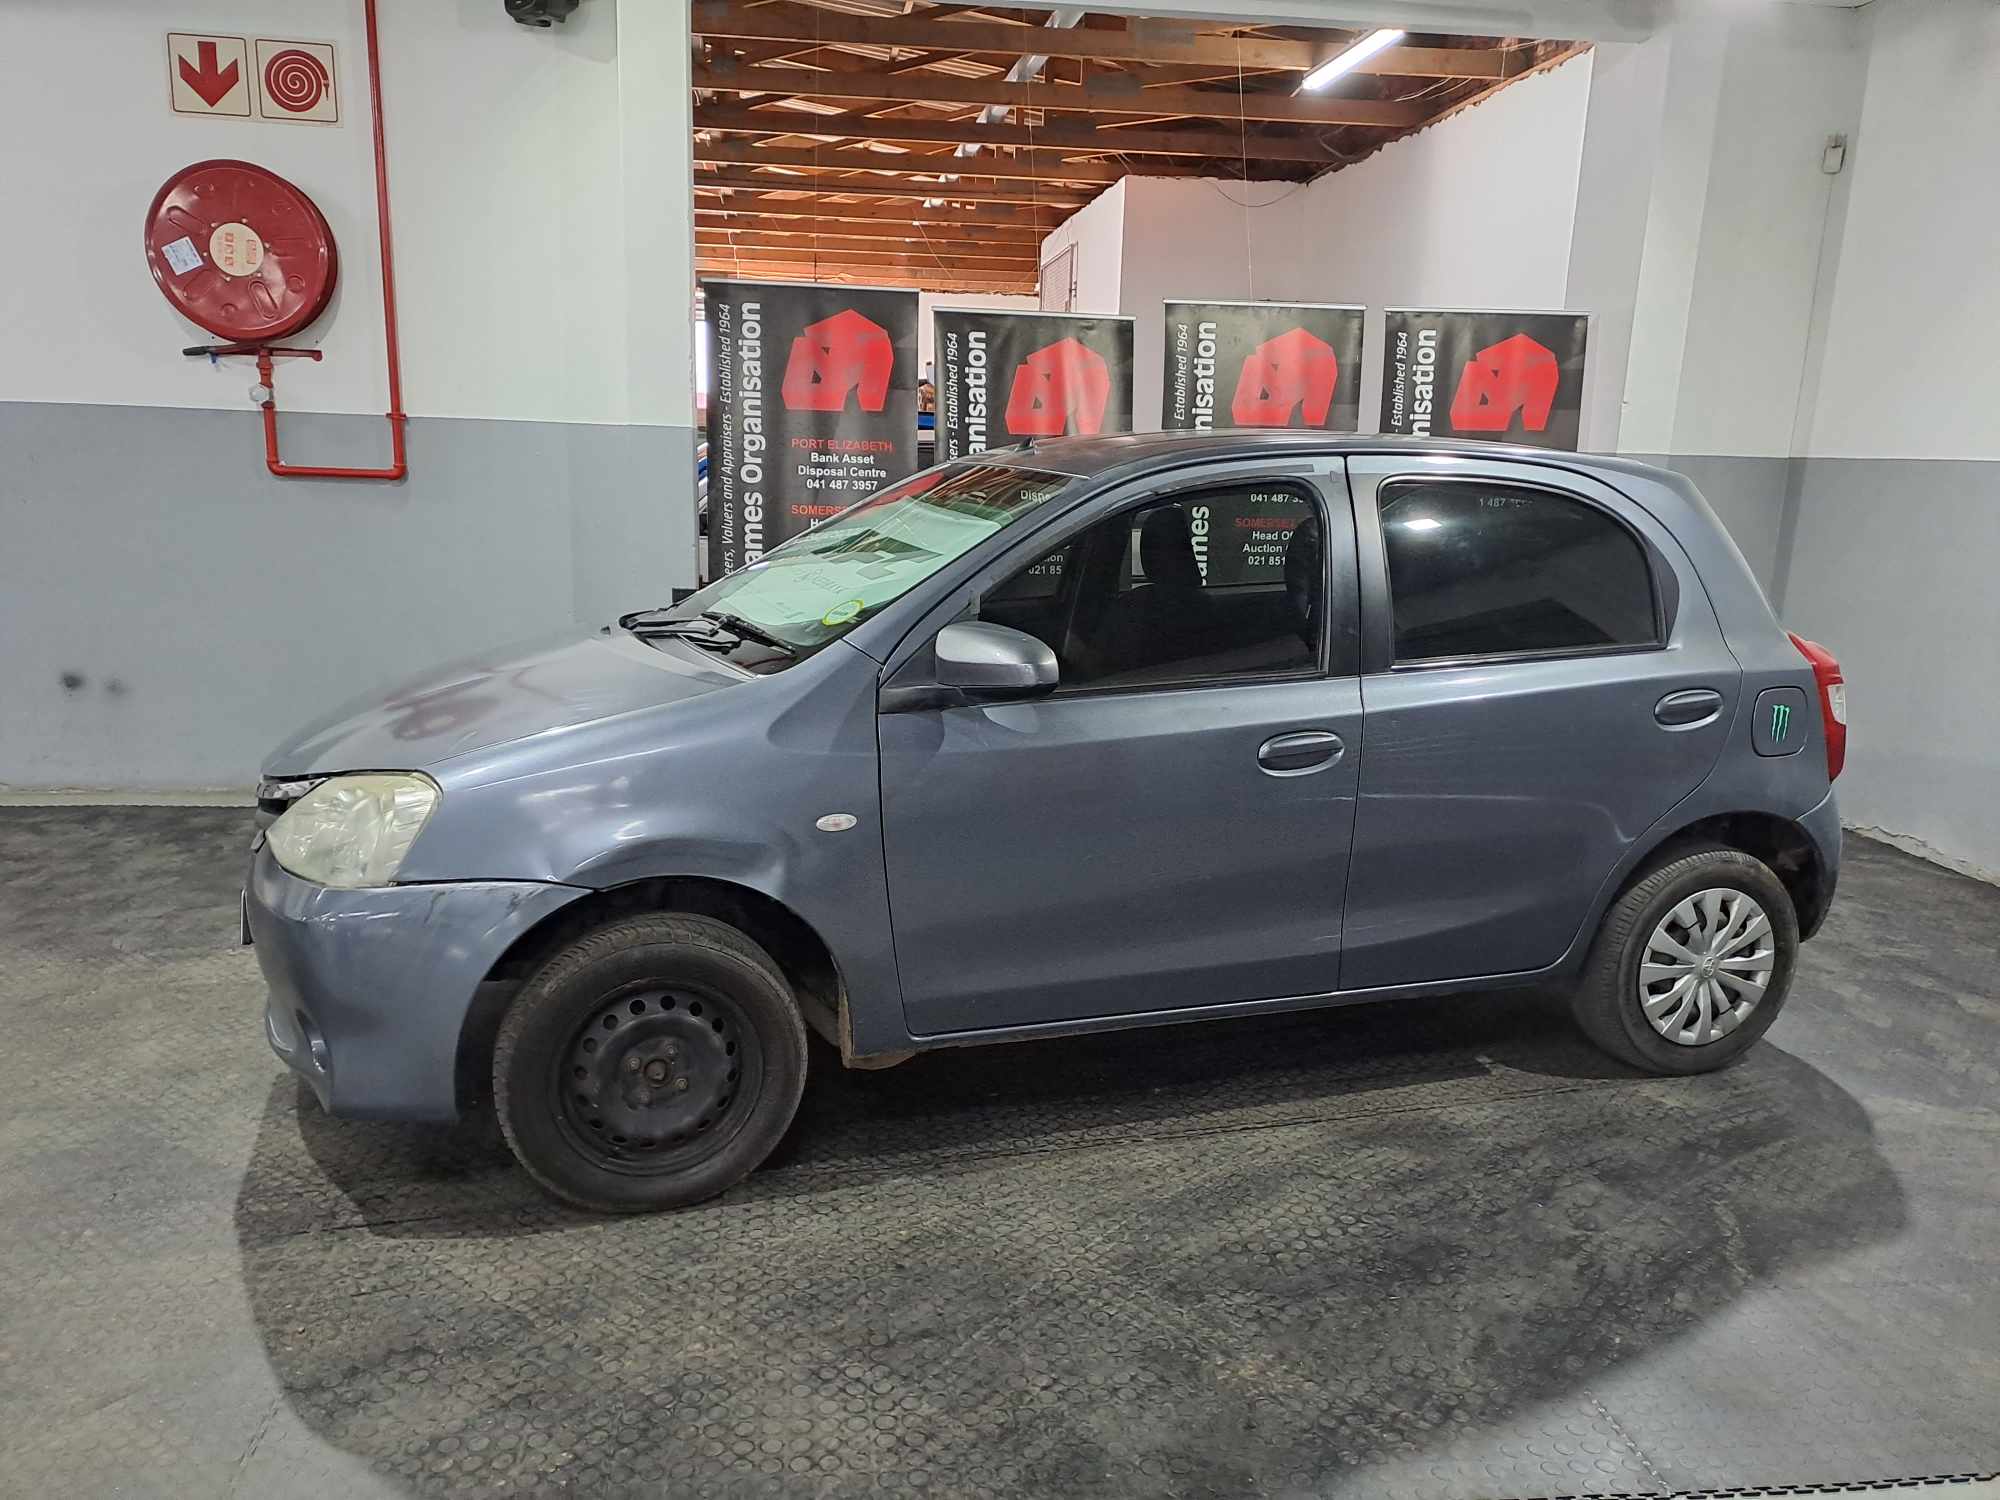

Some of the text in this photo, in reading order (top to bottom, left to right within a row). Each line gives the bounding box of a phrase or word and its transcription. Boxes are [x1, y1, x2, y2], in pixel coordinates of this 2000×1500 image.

[718, 303, 731, 333] 1964
[946, 332, 959, 361] 1964
[1177, 324, 1189, 352] 1964
[1396, 331, 1409, 359] 1964
[718, 336, 732, 404] Established
[737, 302, 767, 484] Organisation
[946, 363, 959, 430] Established
[1174, 354, 1188, 420] Established
[1391, 362, 1406, 426] Established
[719, 414, 736, 475] Appraisers
[791, 438, 824, 449] PORT
[798, 465, 887, 478] Disposal Centre
[810, 452, 875, 464] Bank Asset
[720, 475, 733, 500] and
[806, 479, 878, 491] 041 487 3957
[1250, 493, 1269, 503] 041
[1271, 493, 1289, 503] 487
[720, 502, 733, 545] Valuers
[1252, 531, 1279, 540] Head
[1242, 543, 1283, 554] Auction
[1248, 556, 1286, 565] 021 851
[1049, 565, 1062, 575] 85
